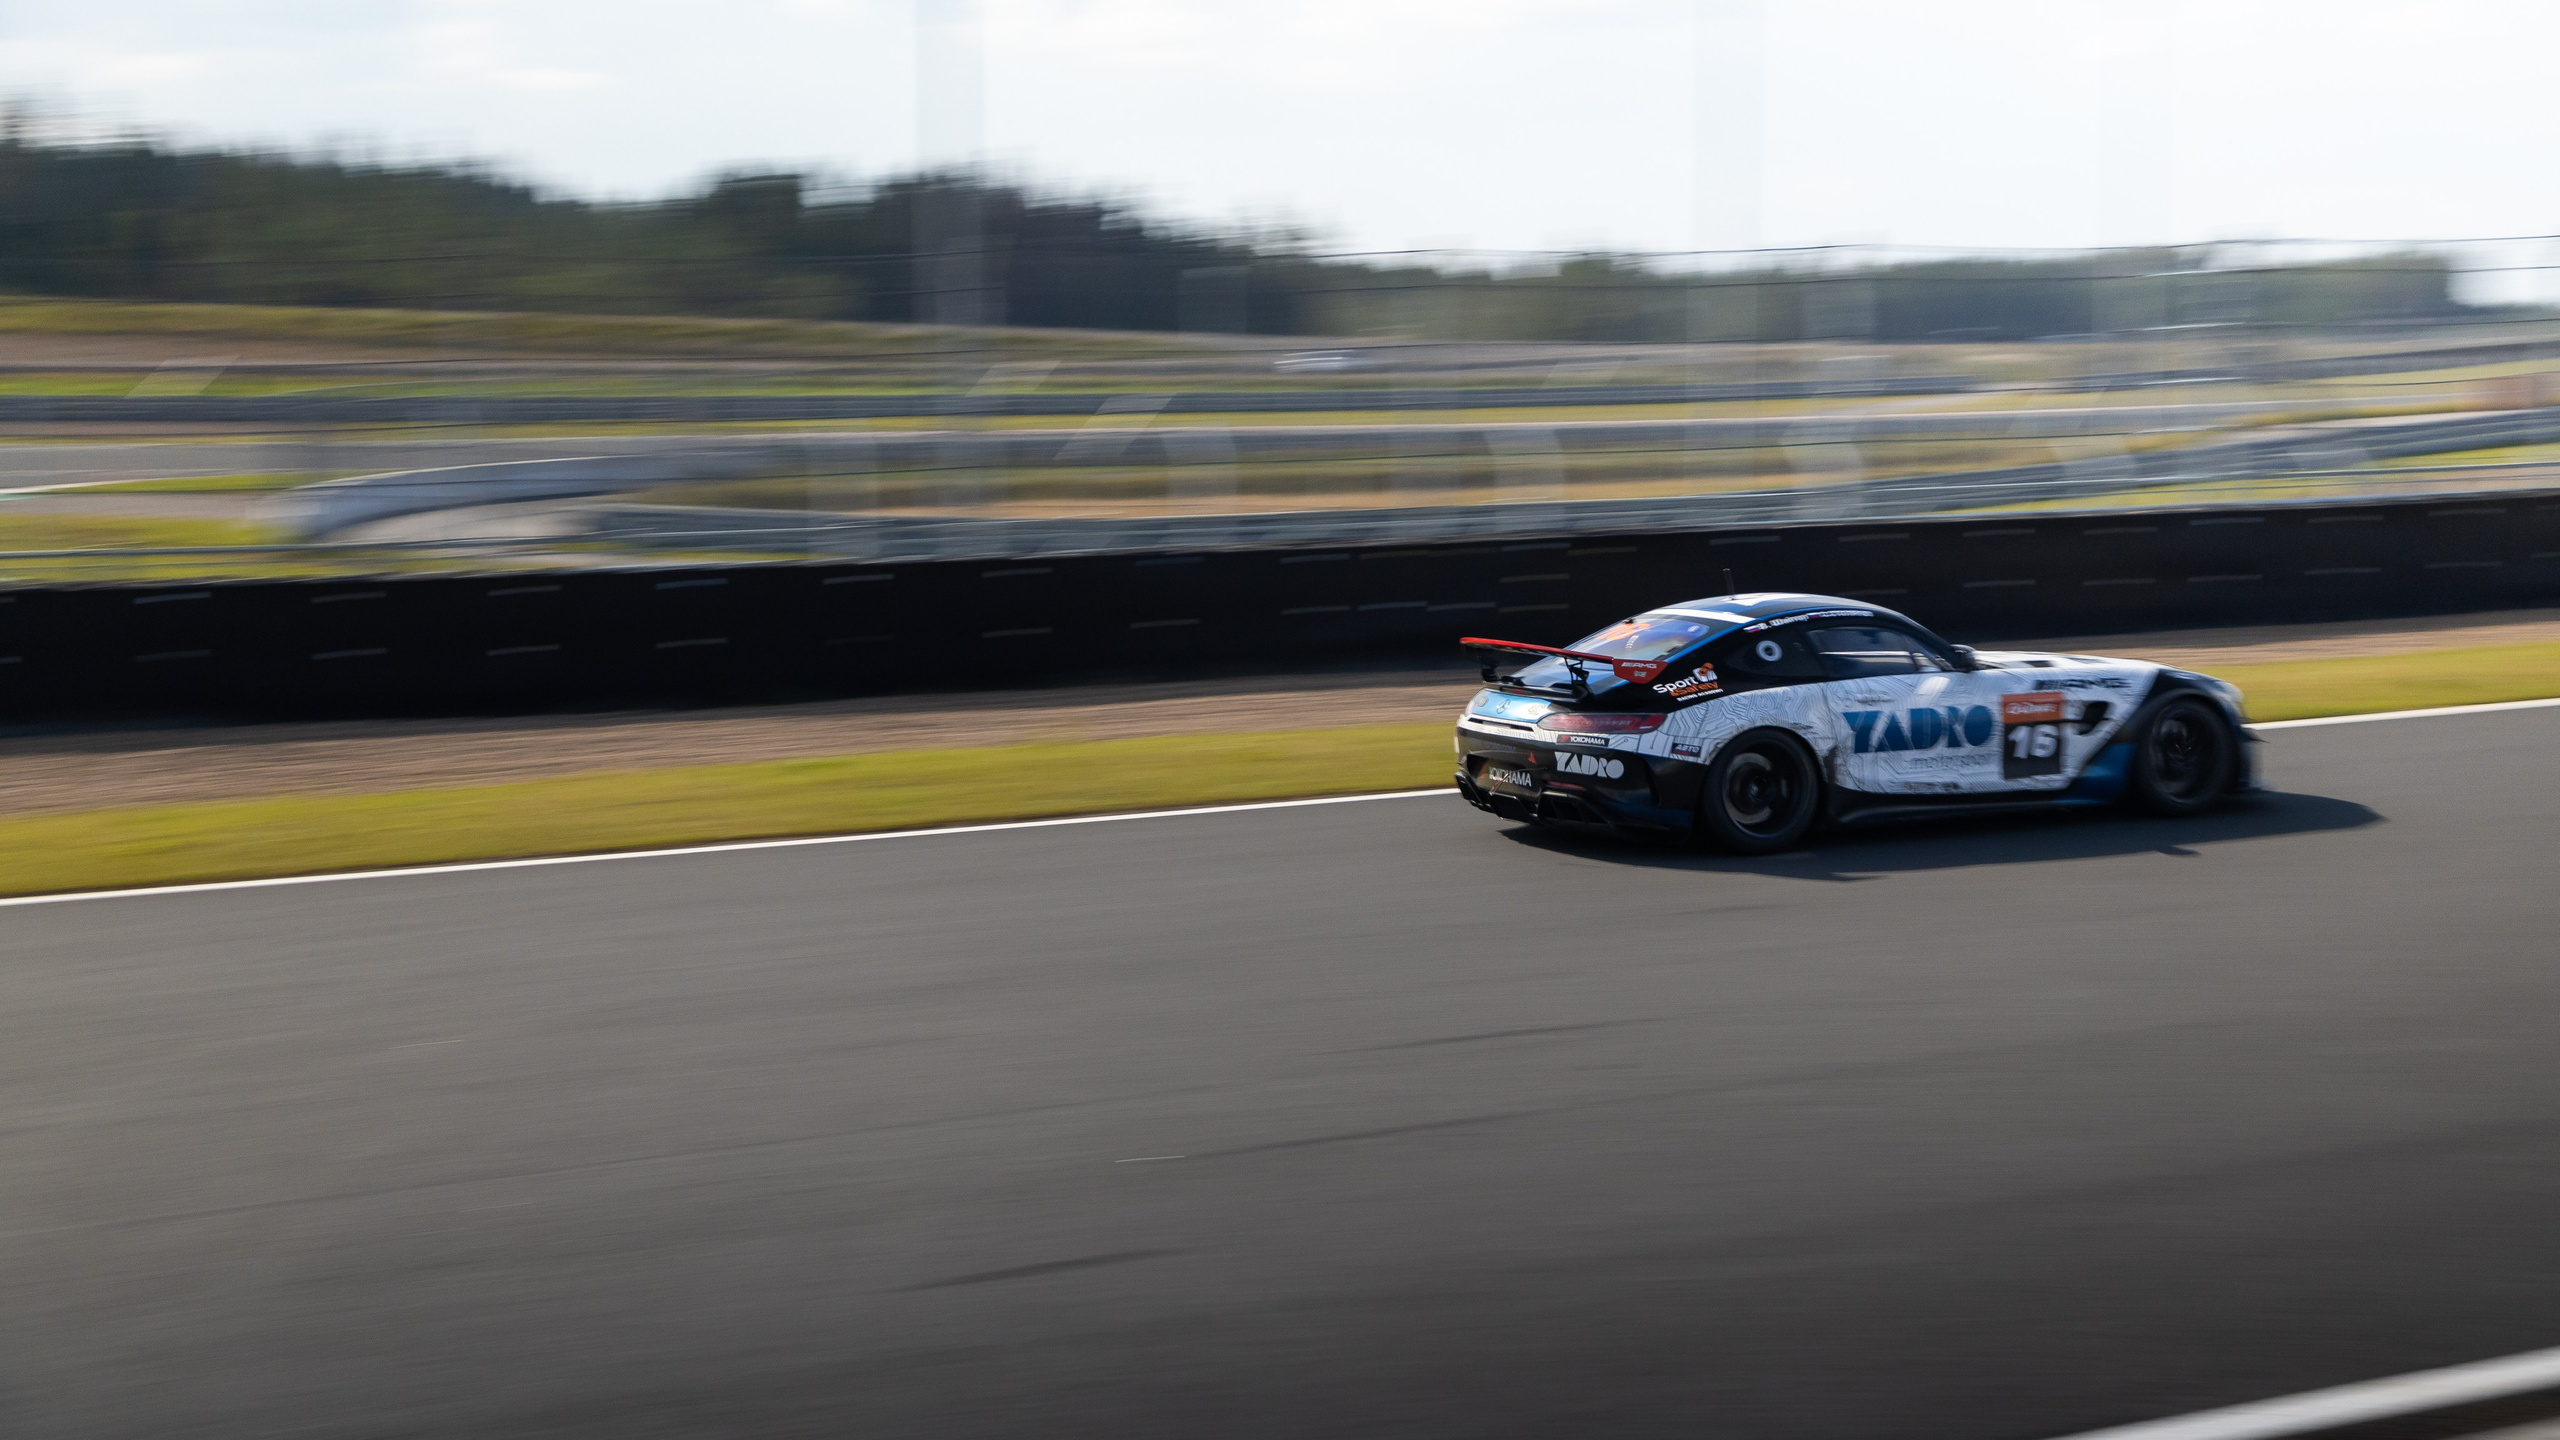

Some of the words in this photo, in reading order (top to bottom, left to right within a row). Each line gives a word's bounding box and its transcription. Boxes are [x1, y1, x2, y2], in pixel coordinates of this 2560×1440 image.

[1652, 676, 1699, 693] Sport
[1570, 734, 1606, 746] YOKOHAMA
[1843, 704, 1993, 754] YADRO
[2007, 724, 2060, 759] 16
[1489, 766, 1532, 787] YOKOHAMA
[1554, 751, 1625, 780] YADRO
